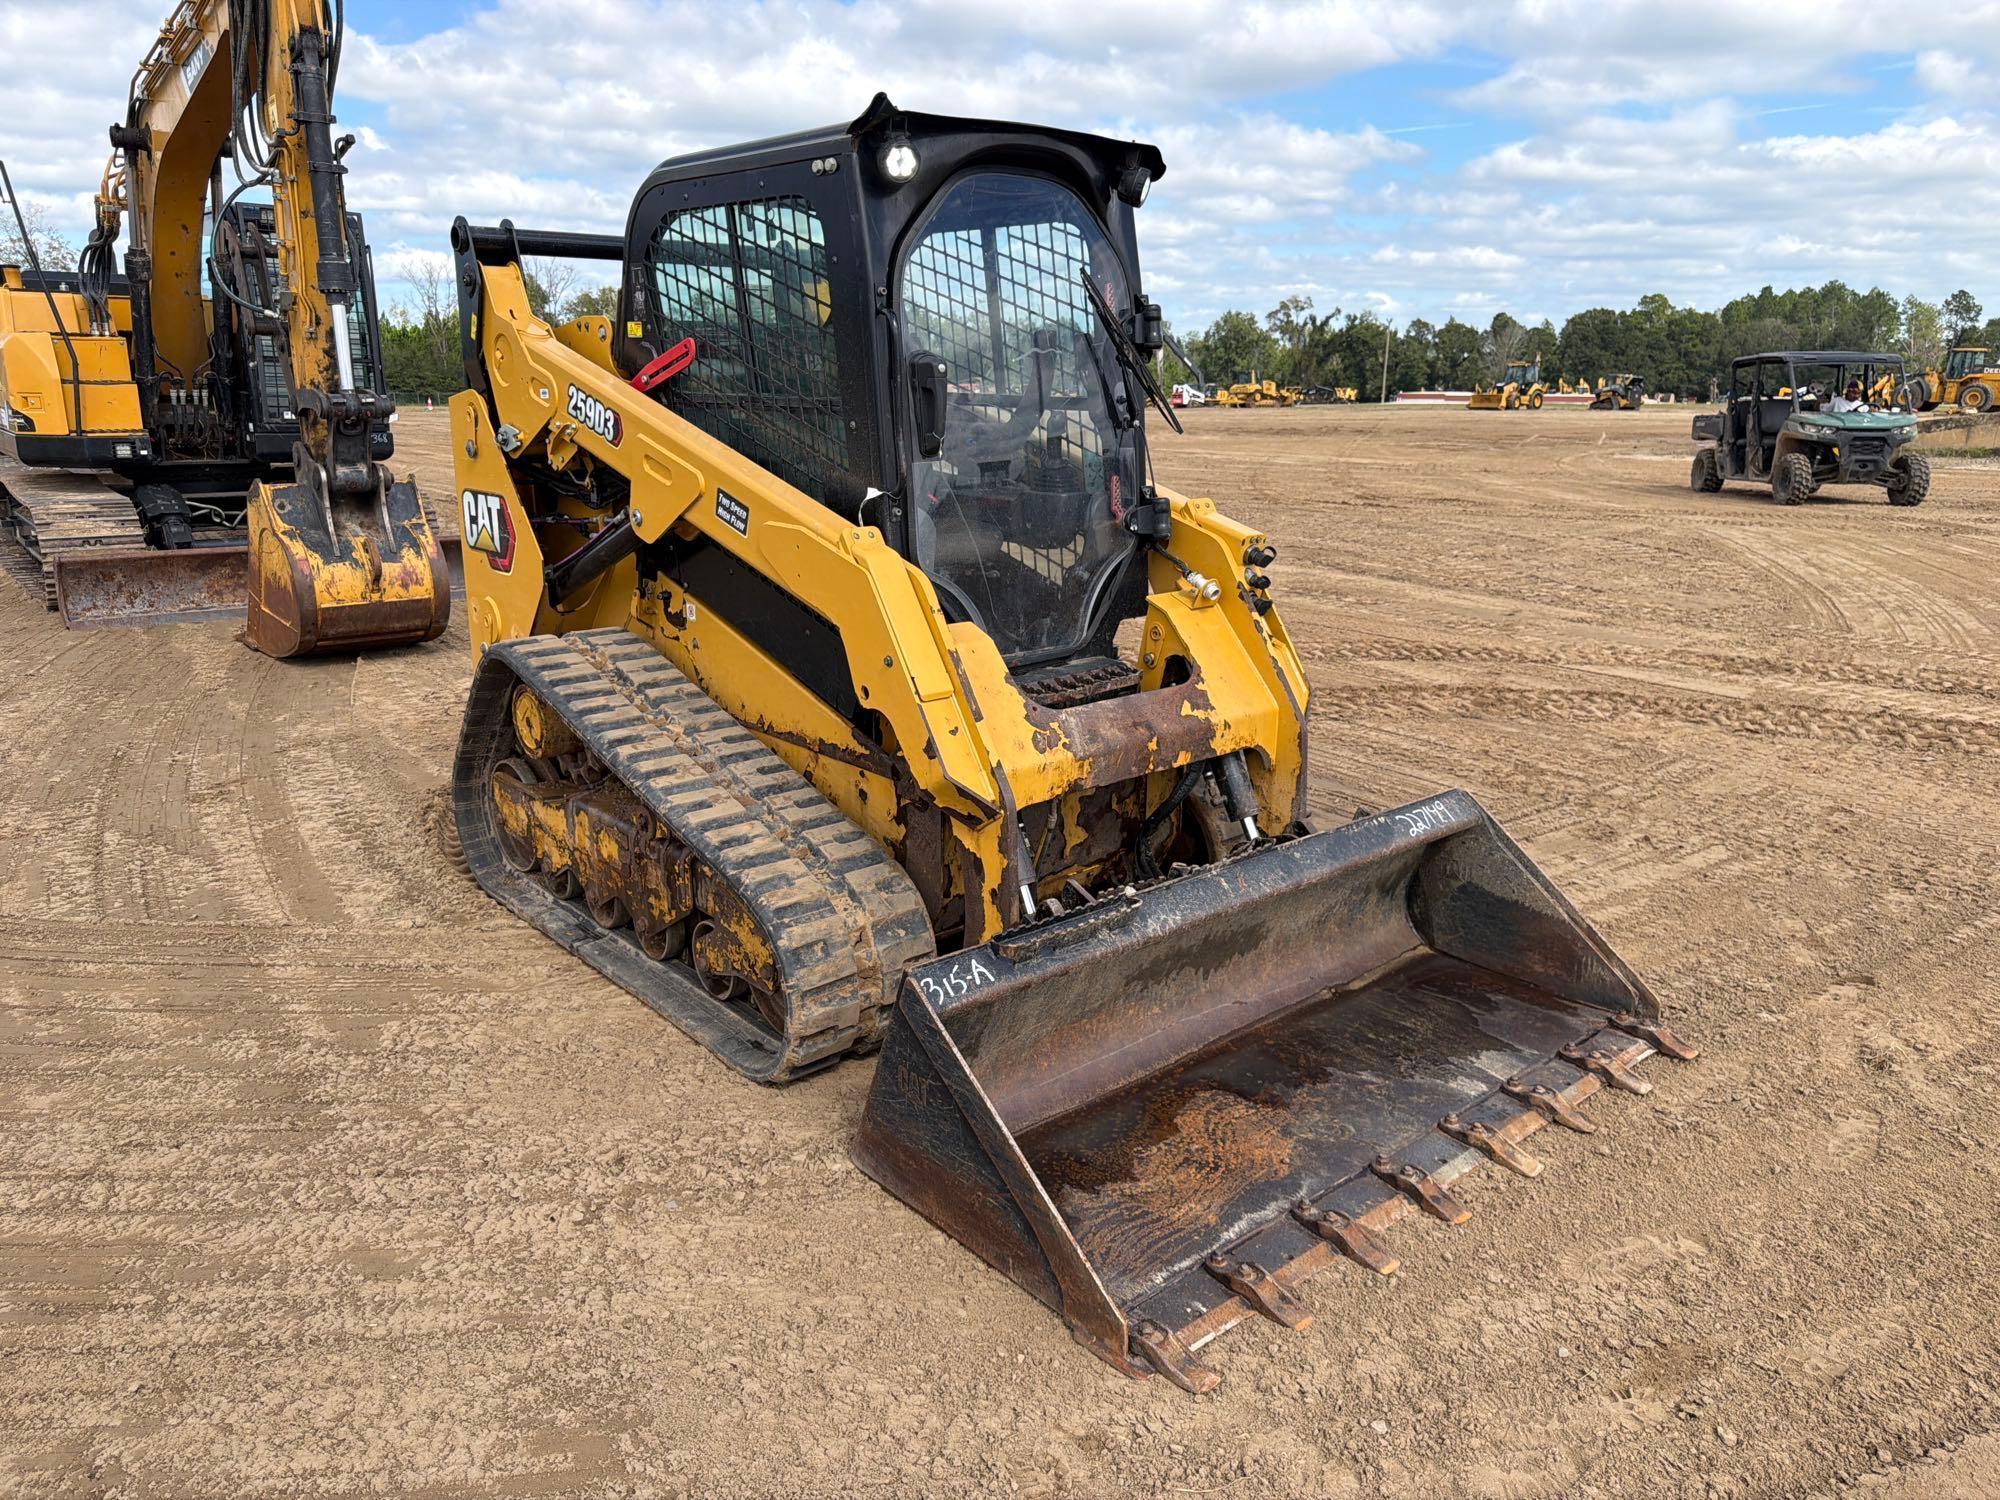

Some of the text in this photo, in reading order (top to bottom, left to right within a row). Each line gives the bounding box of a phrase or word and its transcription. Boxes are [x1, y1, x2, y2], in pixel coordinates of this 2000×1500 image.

[186, 43, 204, 86] SANY
[567, 384, 615, 442] 259D3
[370, 432, 388, 444] 368
[462, 490, 501, 554] CAT
[920, 959, 995, 1006] 315-A
[897, 1064, 930, 1107] CAT
